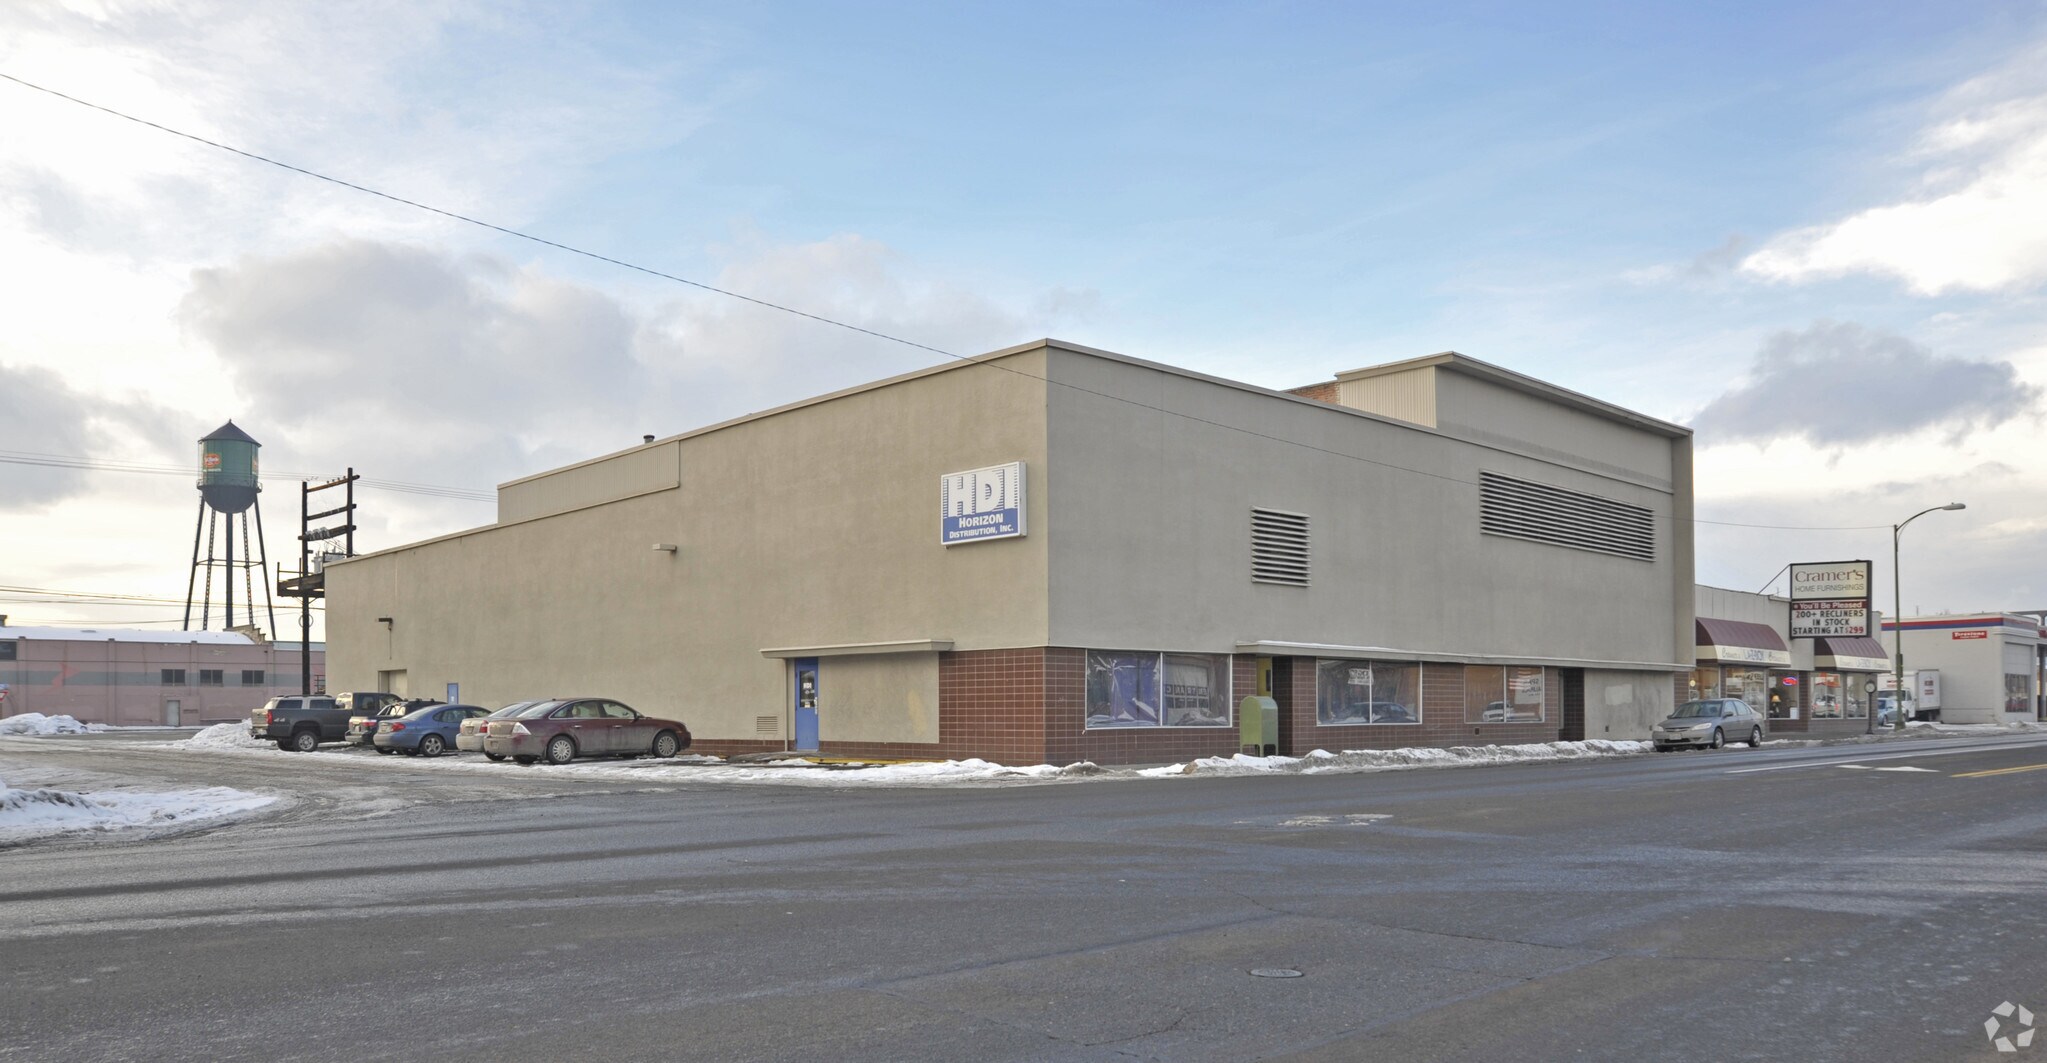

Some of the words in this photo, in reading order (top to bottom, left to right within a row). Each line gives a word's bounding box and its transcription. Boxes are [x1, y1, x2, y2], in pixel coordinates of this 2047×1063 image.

[947, 466, 1016, 517] HDI
[958, 513, 1004, 528] HORIZON
[949, 526, 998, 539] DISTRIBUTION,
[999, 524, 1014, 532] INC.
[1795, 569, 1864, 582] Cramer's
[1825, 618, 1850, 626] STOCK
[1792, 627, 1831, 635] STARTING
